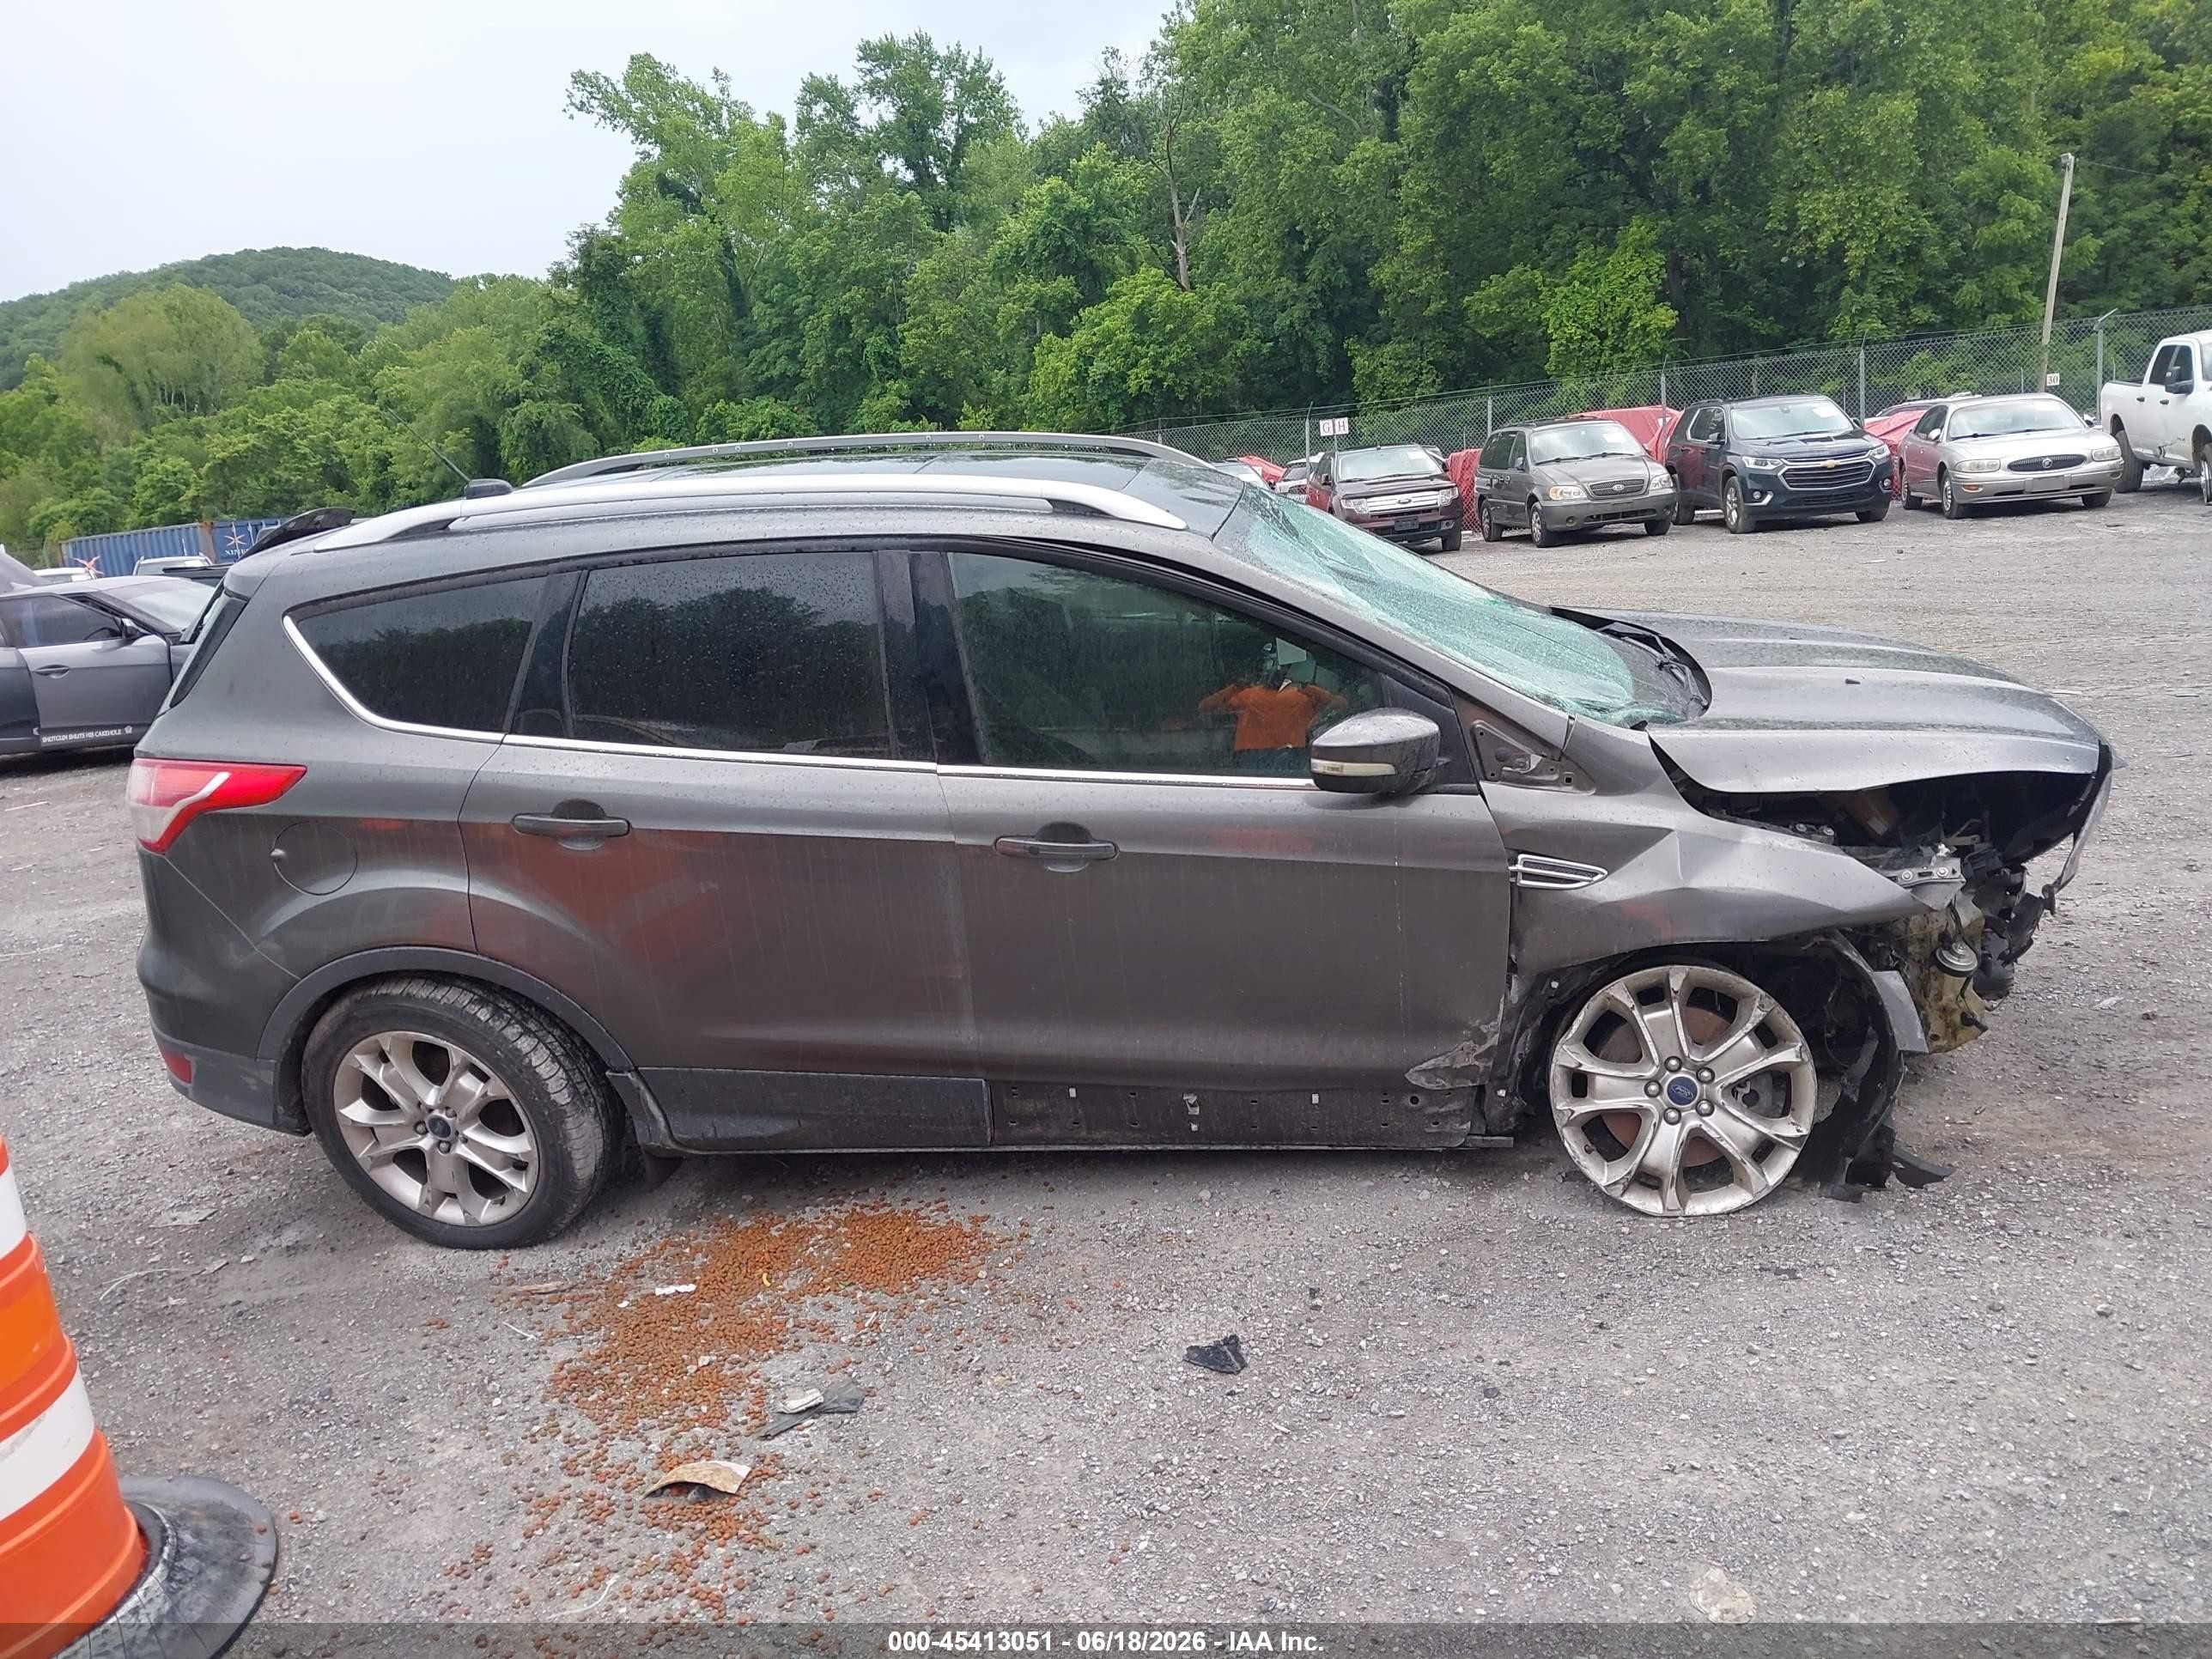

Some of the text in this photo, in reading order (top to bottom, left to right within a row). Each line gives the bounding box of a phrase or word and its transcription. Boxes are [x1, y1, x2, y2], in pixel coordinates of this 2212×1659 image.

[2047, 375, 2058, 385] 30
[1322, 422, 1330, 433] G
[1338, 421, 1346, 431] H
